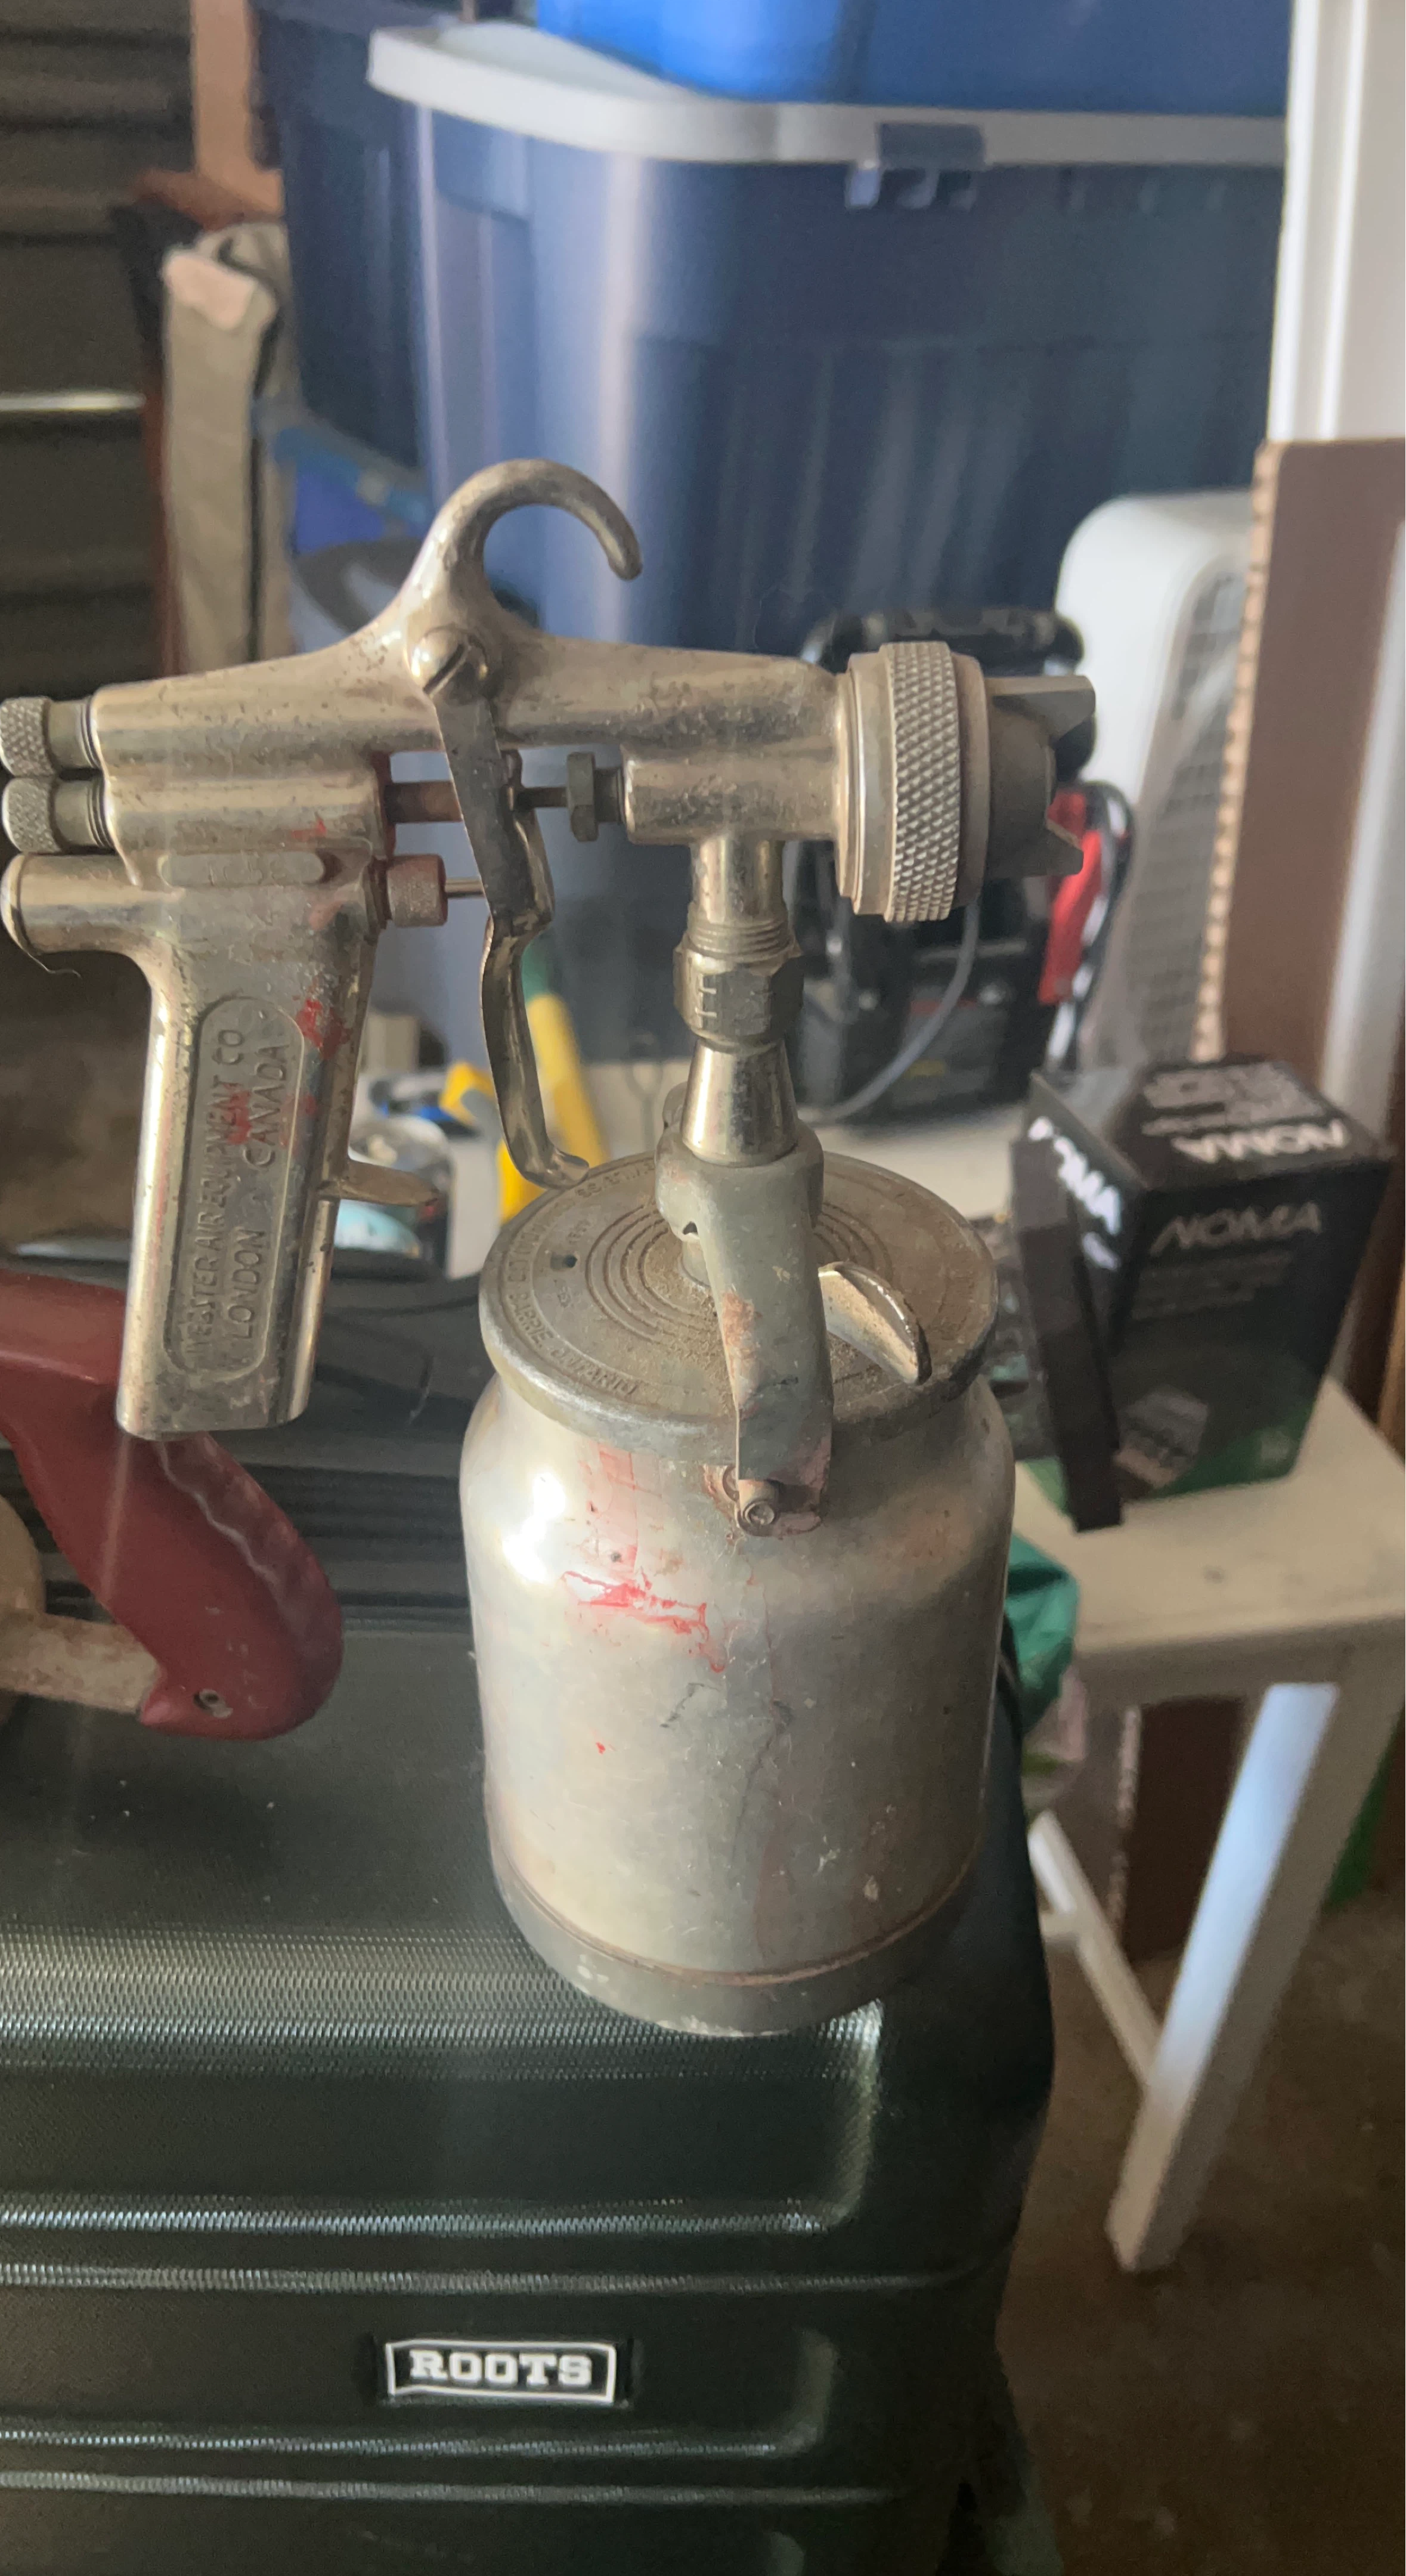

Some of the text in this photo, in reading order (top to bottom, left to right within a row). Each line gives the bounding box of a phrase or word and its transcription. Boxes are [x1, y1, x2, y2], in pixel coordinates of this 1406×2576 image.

[194, 1211, 225, 1251] AIR
[211, 1029, 244, 1066] CO
[228, 1045, 290, 1339] LONDON CANADA
[408, 2349, 593, 2388] ROOTS
